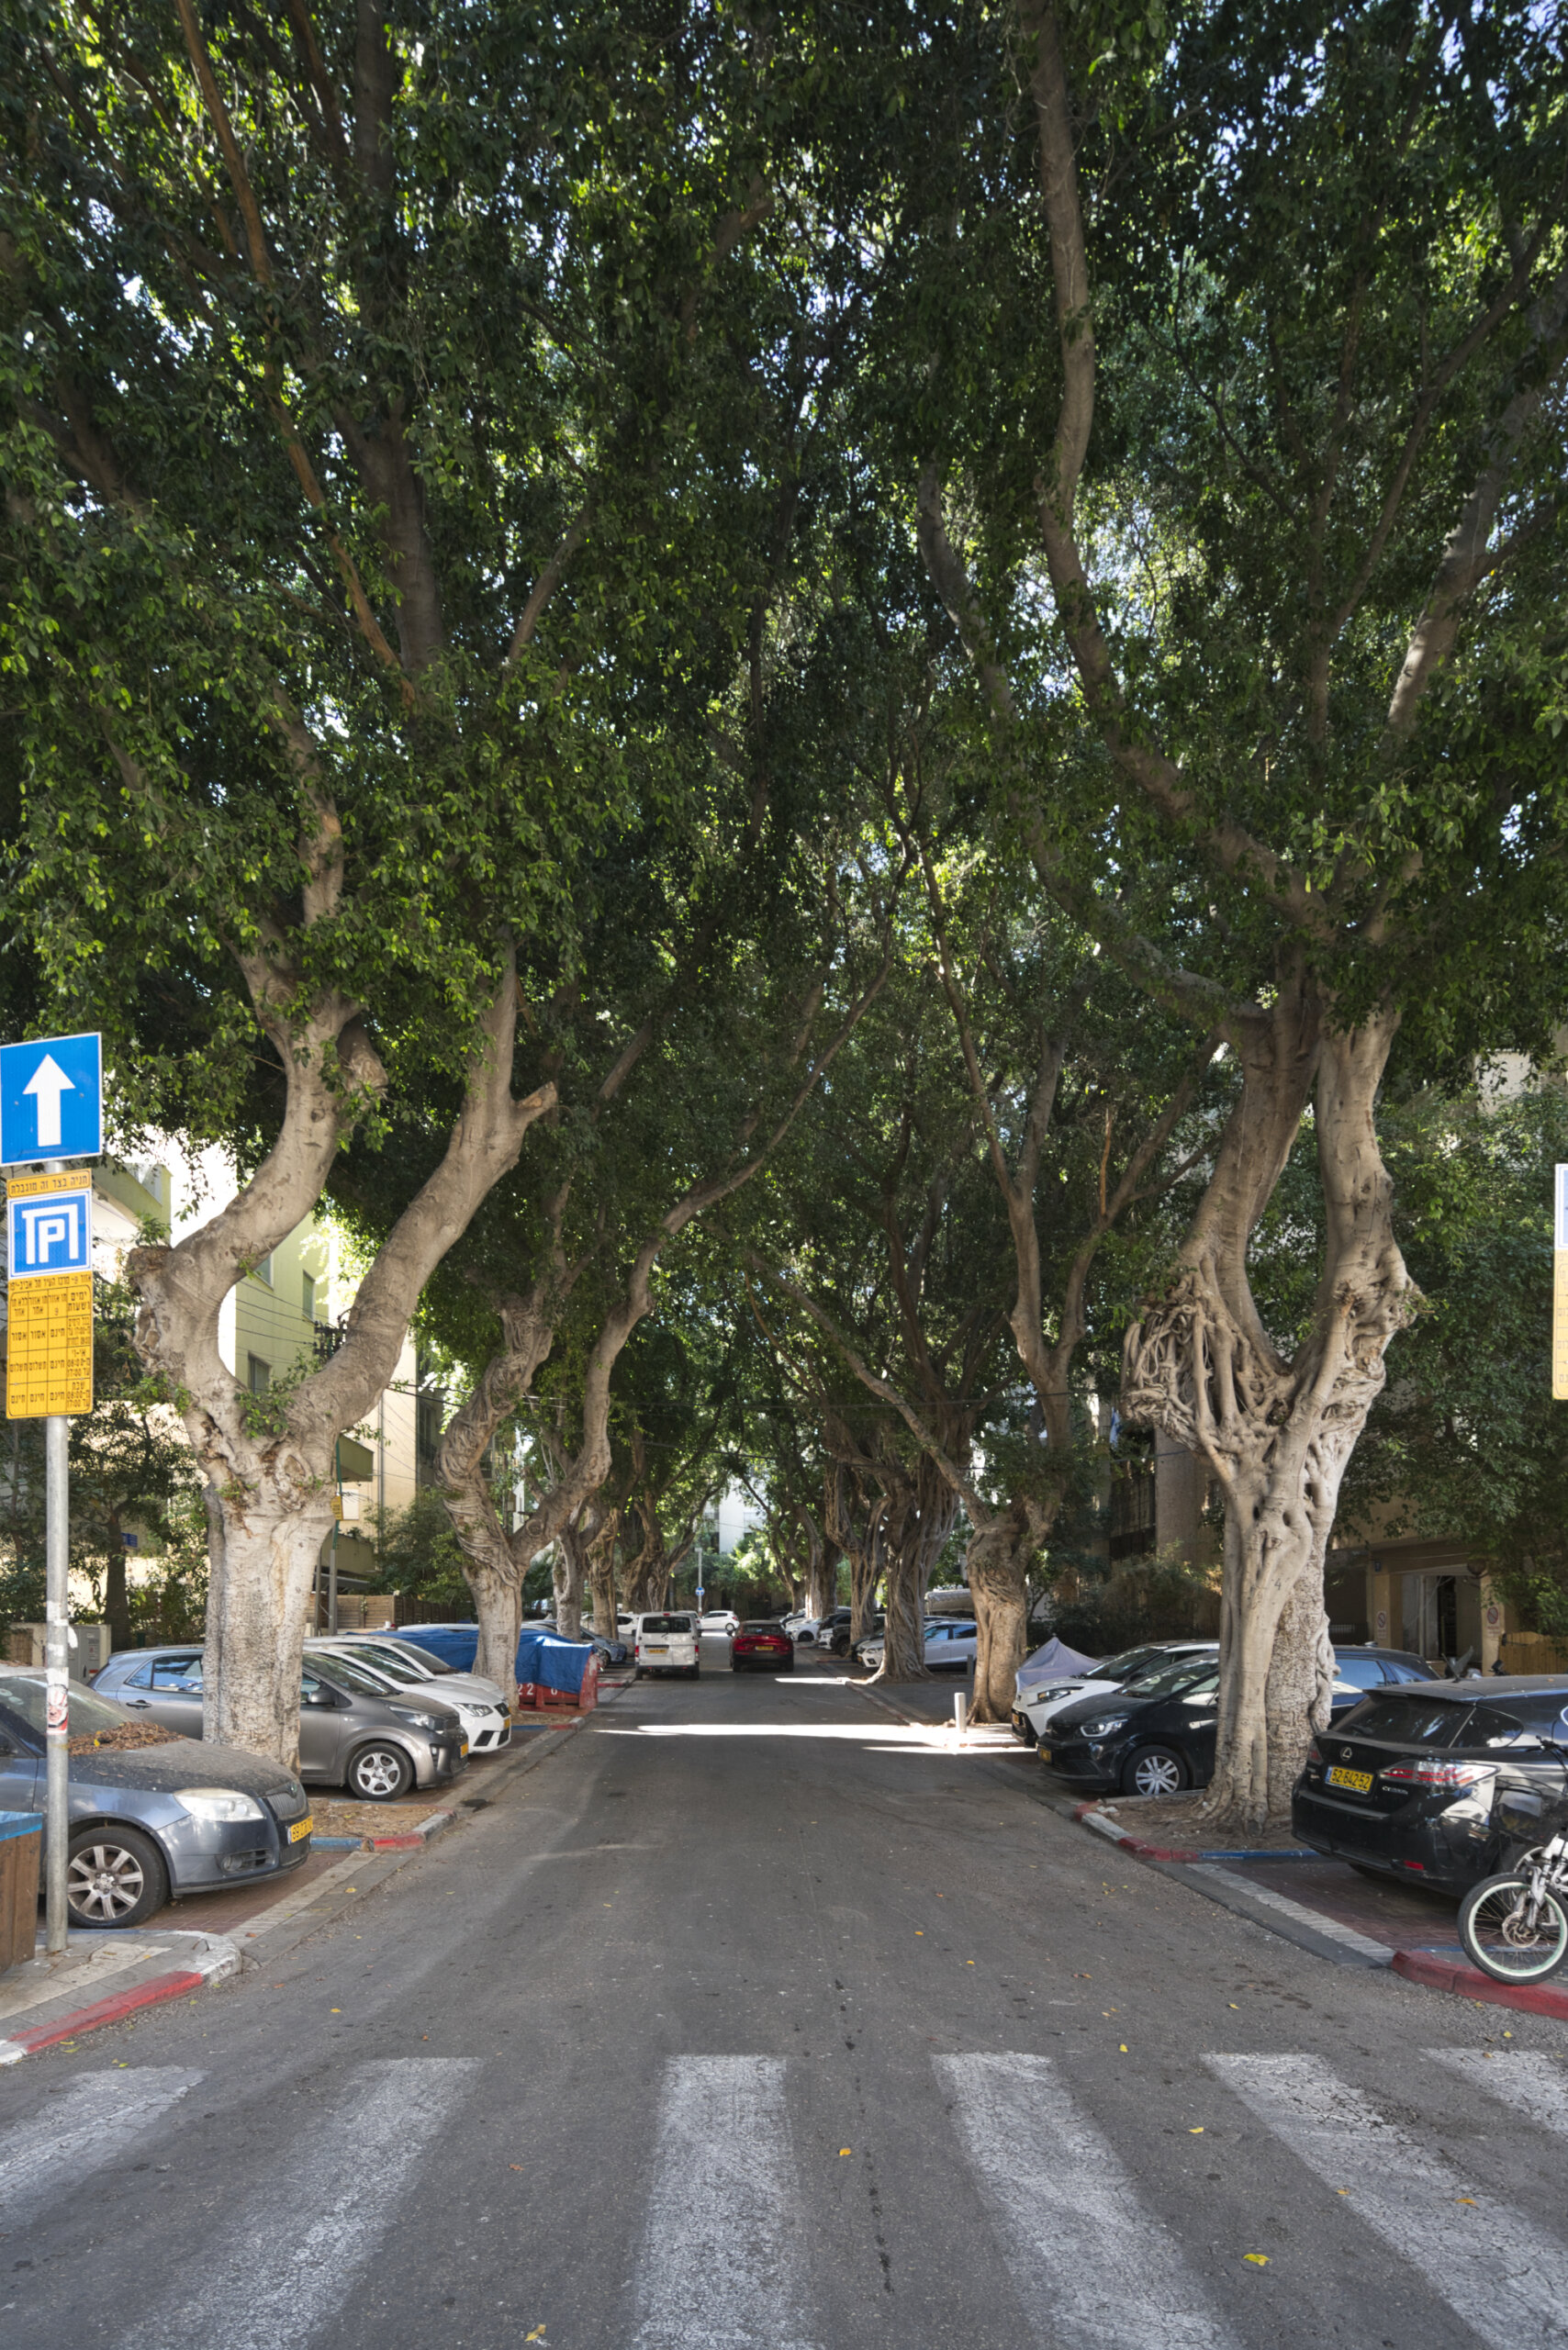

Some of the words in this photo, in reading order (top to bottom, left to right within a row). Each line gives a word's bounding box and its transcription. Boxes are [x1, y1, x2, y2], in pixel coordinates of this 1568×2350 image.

[51, 1178, 66, 1188] בצד
[70, 1175, 87, 1186] חניה
[11, 1182, 37, 1193] מוגבלת
[40, 1181, 48, 1191] זה
[71, 1292, 87, 1301] ימים
[12, 1332, 27, 1340] אסור
[30, 1331, 46, 1339] אסור
[50, 1328, 65, 1337] חינם
[50, 1360, 65, 1369] חינם
[11, 1395, 25, 1404] חינם
[30, 1394, 44, 1403] חינם
[50, 1393, 64, 1401] חינם
